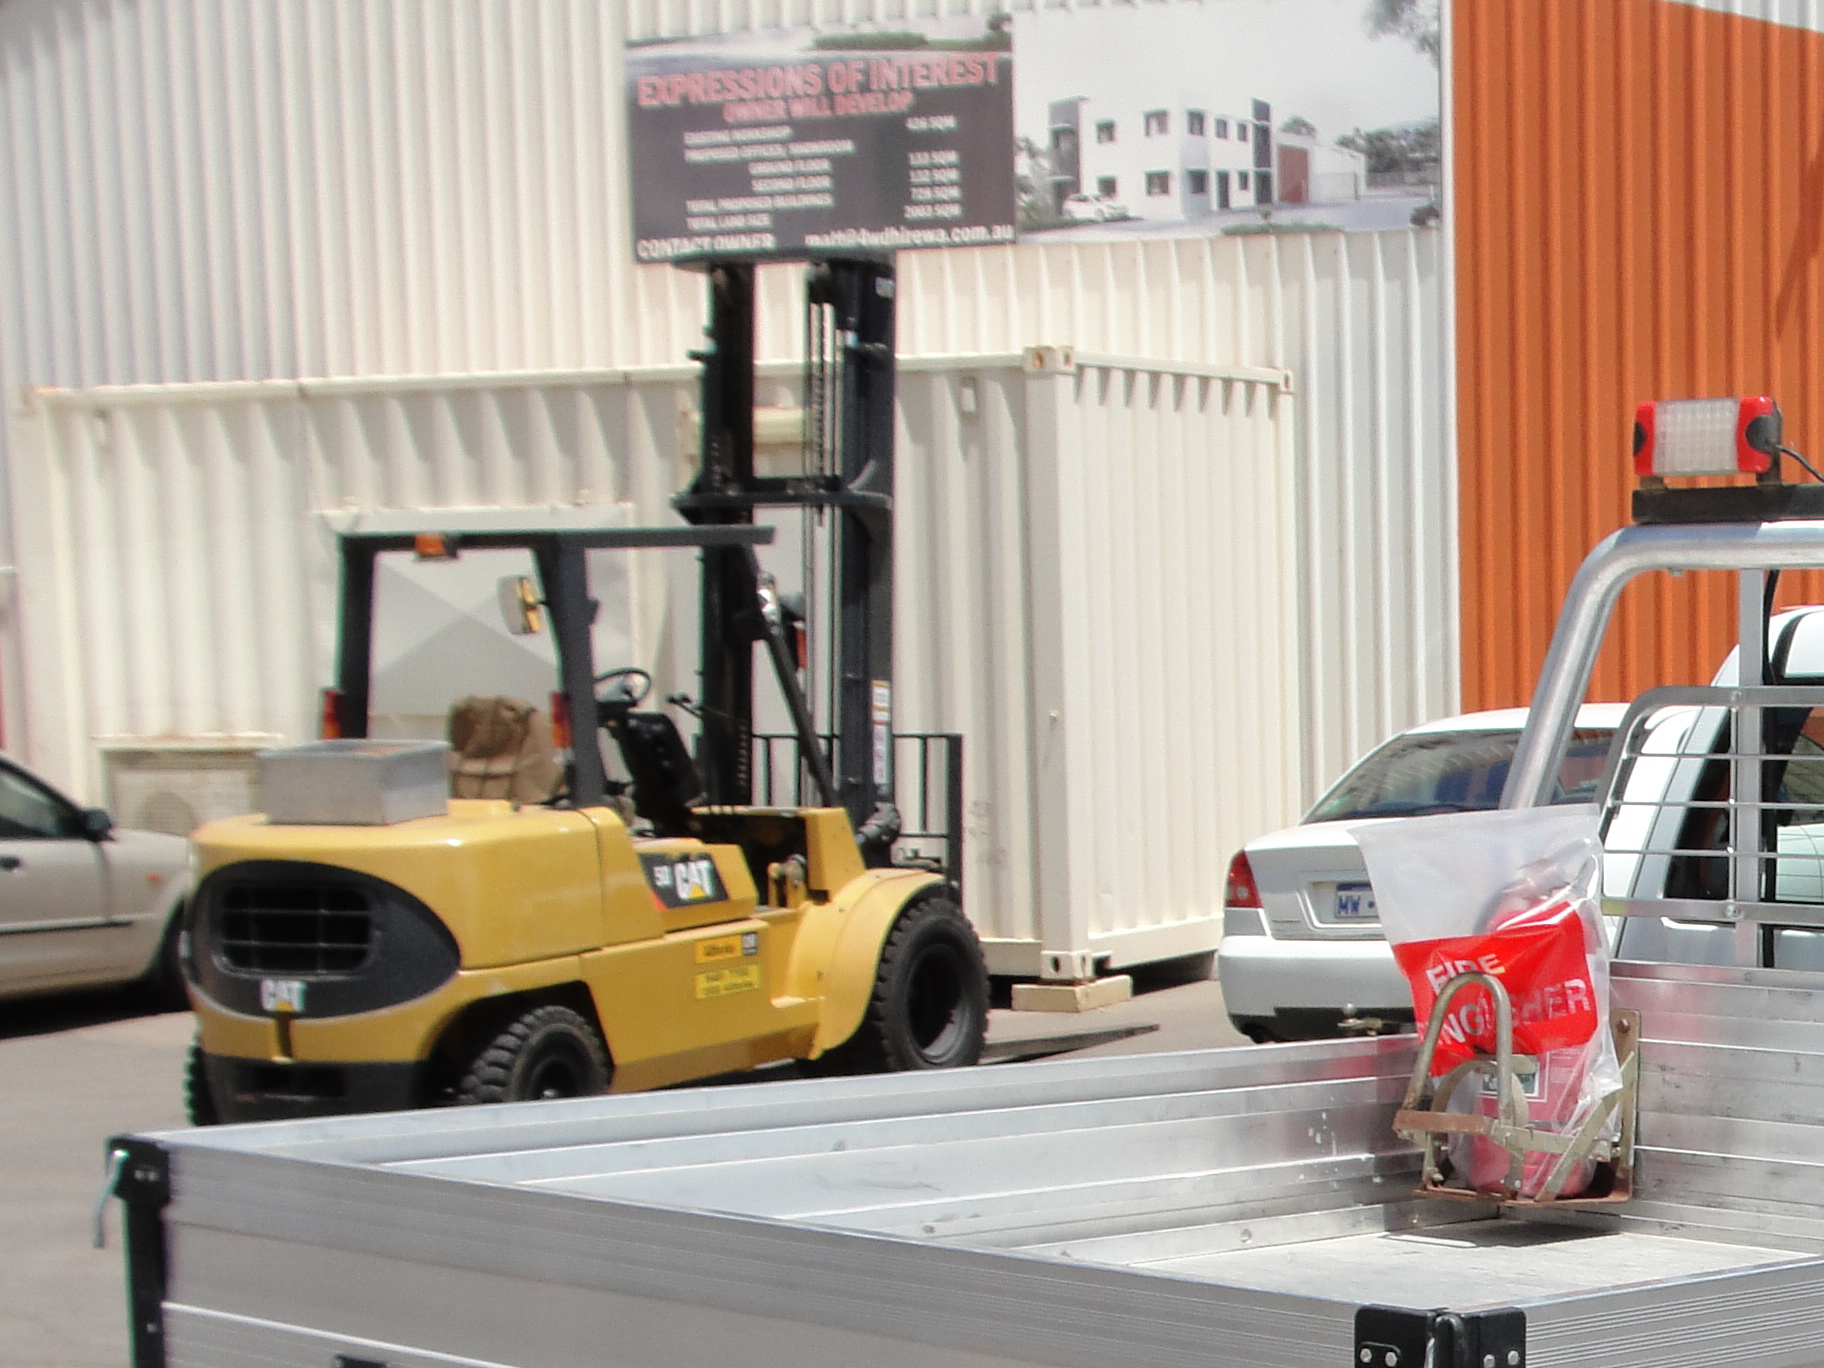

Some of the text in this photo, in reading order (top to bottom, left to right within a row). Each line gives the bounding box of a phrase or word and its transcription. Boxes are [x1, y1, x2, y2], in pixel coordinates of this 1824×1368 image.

[637, 52, 999, 106] EXPRESSIONS OF INTEREST
[833, 89, 913, 115] DEVELOP
[637, 233, 776, 258] CONTACT OWNER
[674, 859, 713, 900] CAT
[261, 980, 305, 1012] CAT
